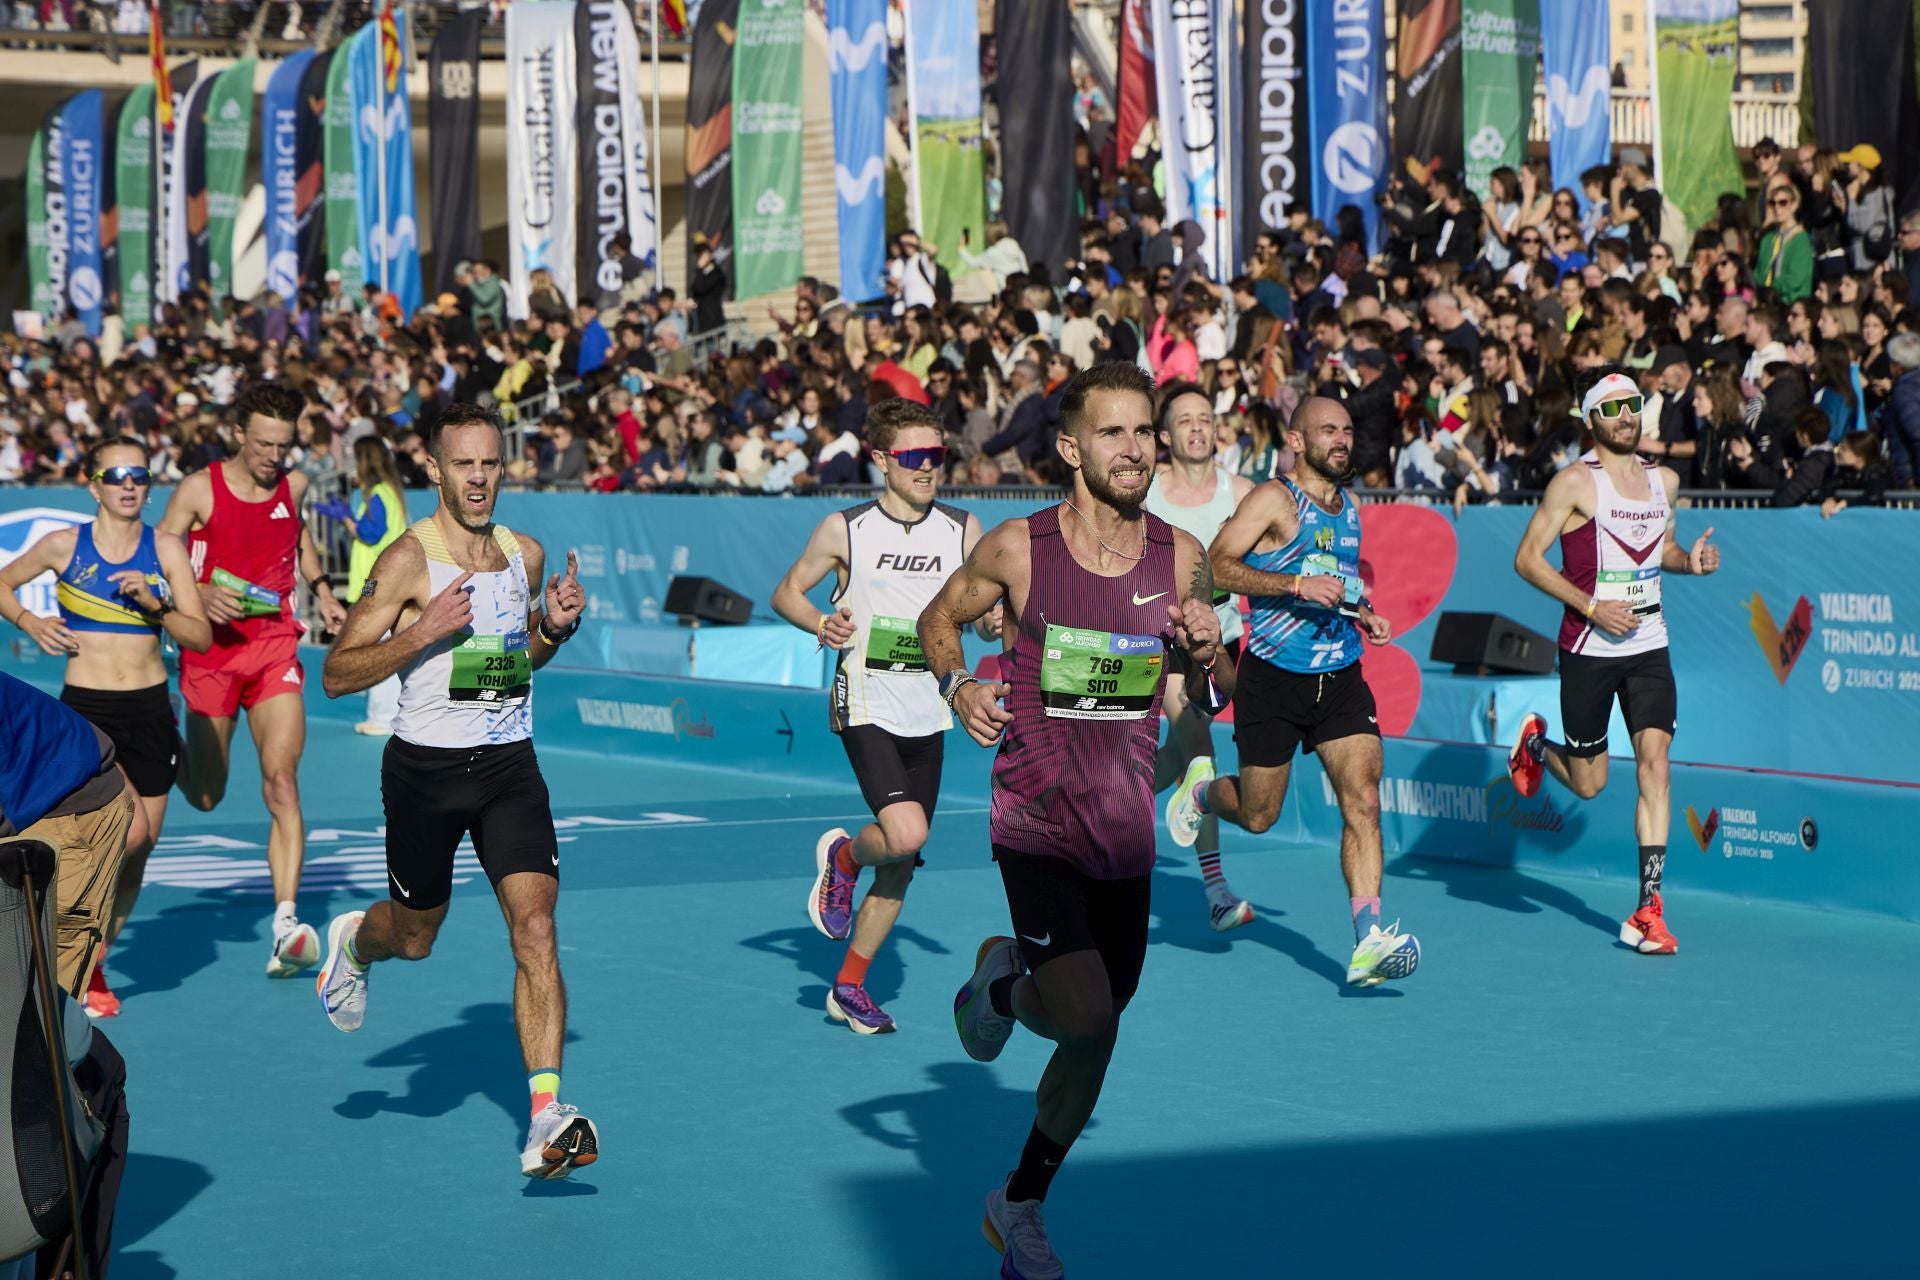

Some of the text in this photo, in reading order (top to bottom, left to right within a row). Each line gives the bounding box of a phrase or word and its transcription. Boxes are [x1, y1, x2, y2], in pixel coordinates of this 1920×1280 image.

[589, 2, 618, 93] new
[1333, 0, 1372, 97] ZUR
[1171, 0, 1219, 152] CaixaB
[523, 46, 554, 228] CaixaBank
[275, 109, 297, 236] ZURICH
[71, 138, 96, 255] ZURICH
[1611, 509, 1665, 521] BORDEAUX
[876, 553, 941, 572] FUGA
[1626, 584, 1644, 596] 104
[1820, 592, 1893, 623] VALENCIA
[896, 635, 922, 648] 225
[1822, 628, 1920, 657] TRINIDAD AL
[485, 655, 515, 671] 2326
[1089, 656, 1123, 675] 769
[477, 673, 518, 688] YOHANN
[1087, 679, 1118, 694] SITO
[1845, 668, 1894, 689] ZURICH
[836, 674, 847, 713] FUGA
[1397, 778, 1487, 823] MARATHON
[1722, 807, 1757, 825] VALENCIA
[1722, 825, 1797, 846] TRINIDAD ALFONSO
[1734, 846, 1758, 858] ZURICH
